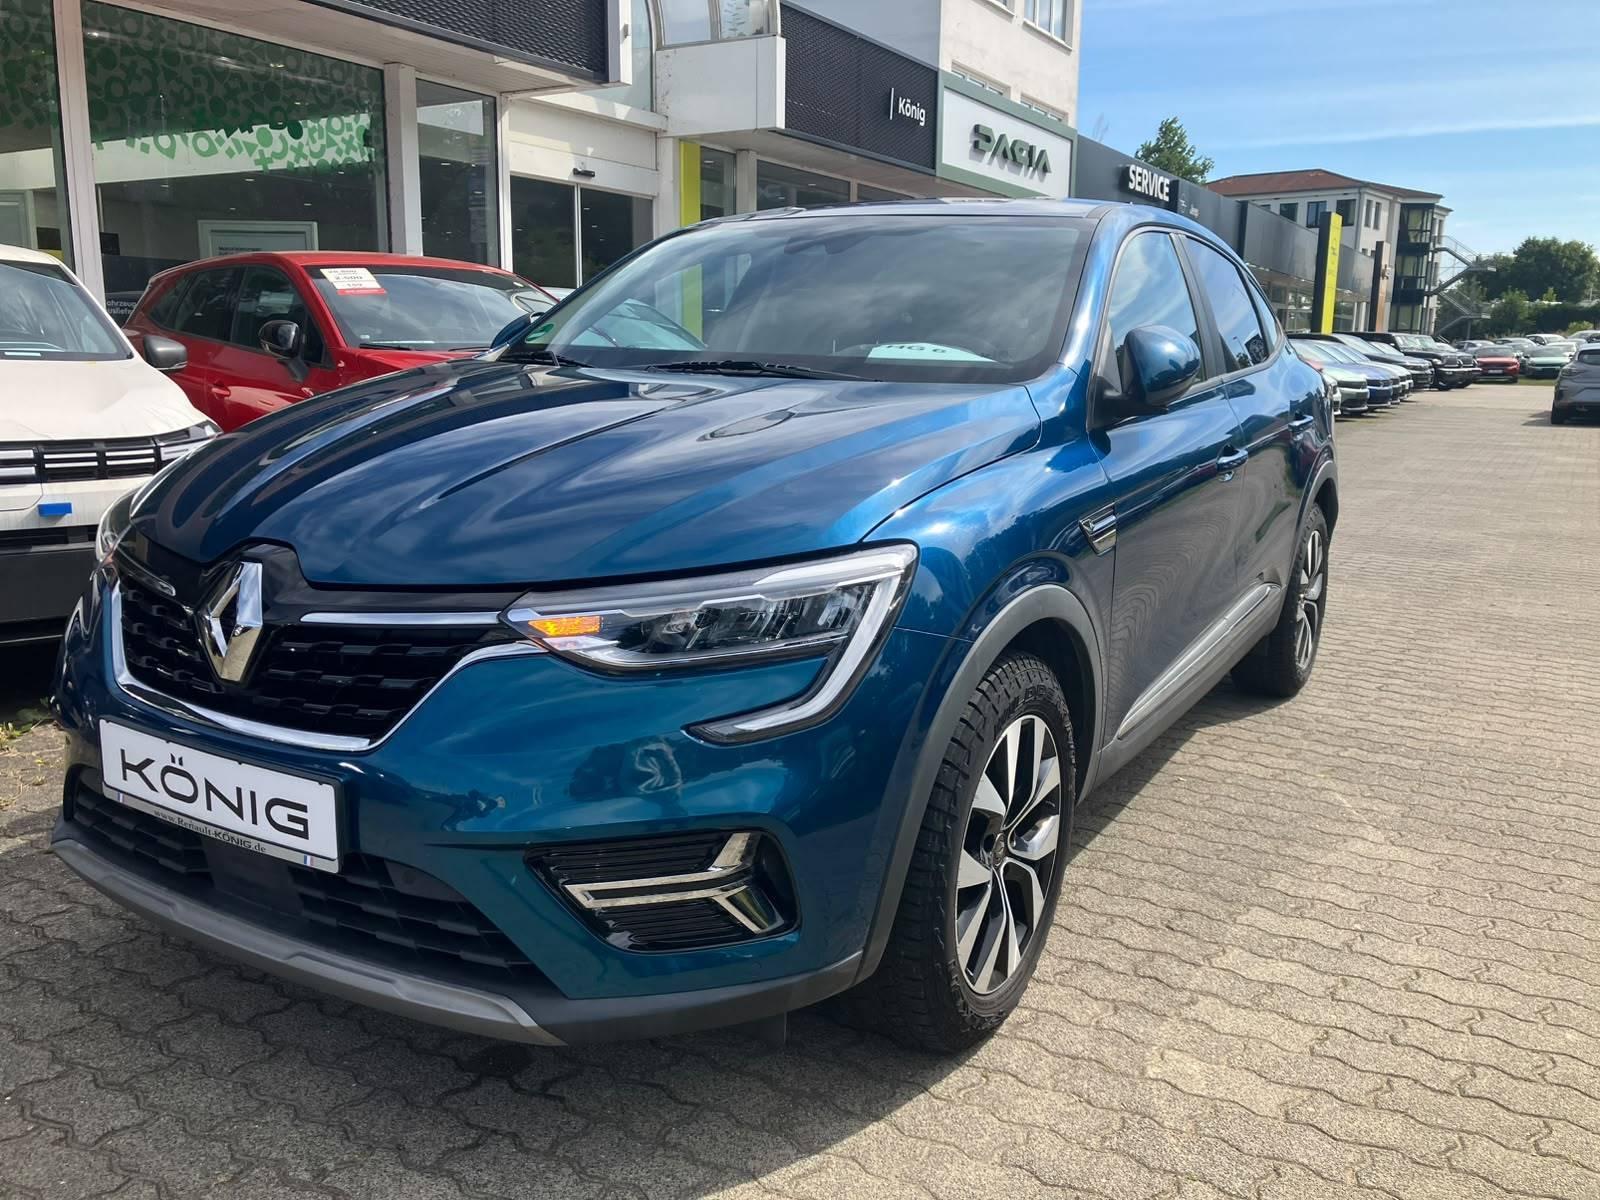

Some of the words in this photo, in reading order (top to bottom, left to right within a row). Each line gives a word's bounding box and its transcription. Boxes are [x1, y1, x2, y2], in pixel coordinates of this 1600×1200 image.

[898, 97, 926, 126] König
[973, 123, 1051, 174] DACIA
[1128, 164, 1170, 202] SERVICE
[120, 748, 310, 841] KÖNIG
[154, 809, 267, 853] www.Renault-KÖNIG.de
